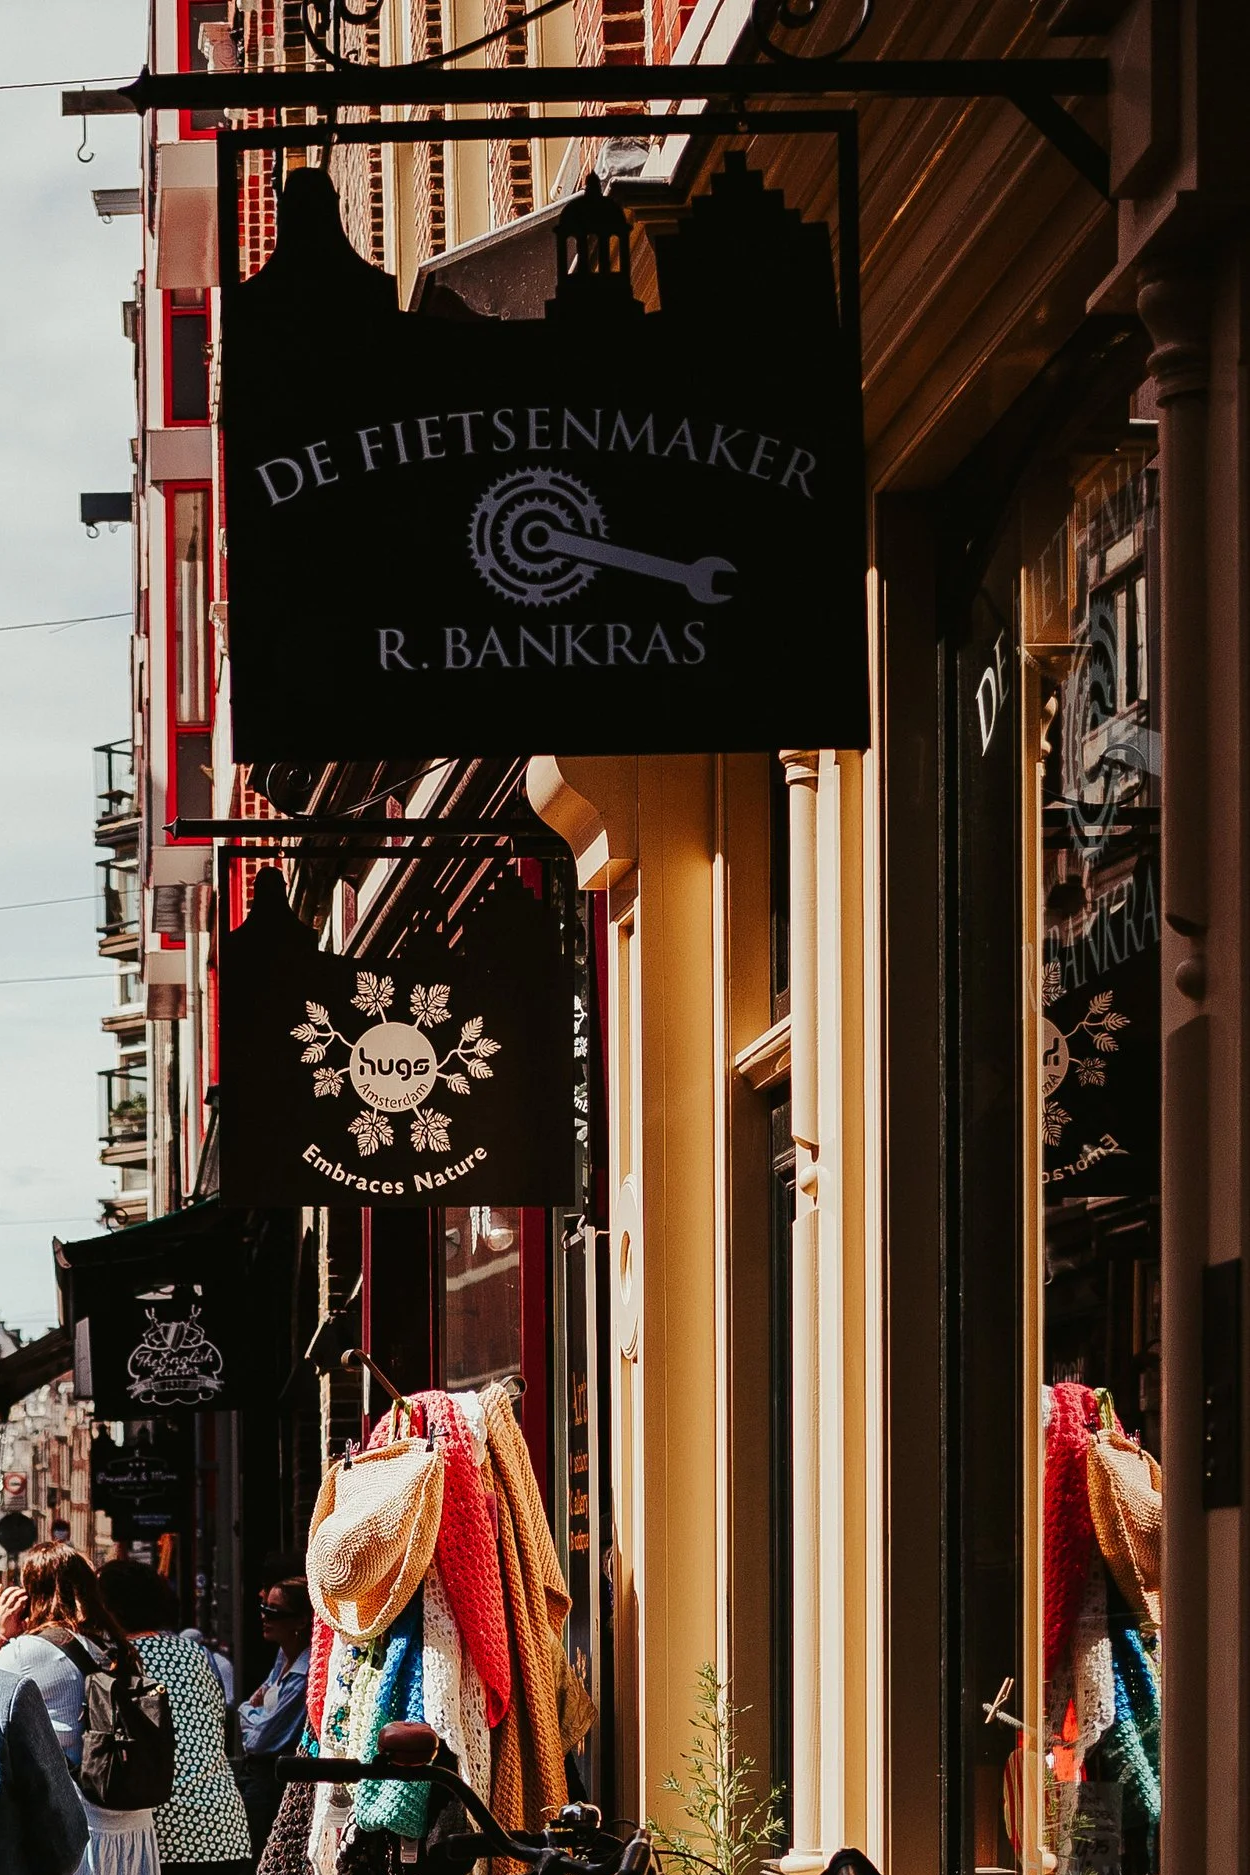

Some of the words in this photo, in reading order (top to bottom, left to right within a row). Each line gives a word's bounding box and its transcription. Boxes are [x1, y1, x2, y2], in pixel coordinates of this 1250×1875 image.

[255, 440, 340, 506] DE
[356, 406, 818, 499] FIETSENMAKER
[378, 628, 429, 671] R.
[443, 621, 707, 670] BANKRAS
[975, 627, 1010, 757] DE
[358, 1047, 431, 1082] hugs
[358, 1081, 428, 1109] Amsterdam
[302, 1143, 405, 1195] Embraces
[413, 1145, 488, 1193] Nature
[158, 1348, 214, 1370] English
